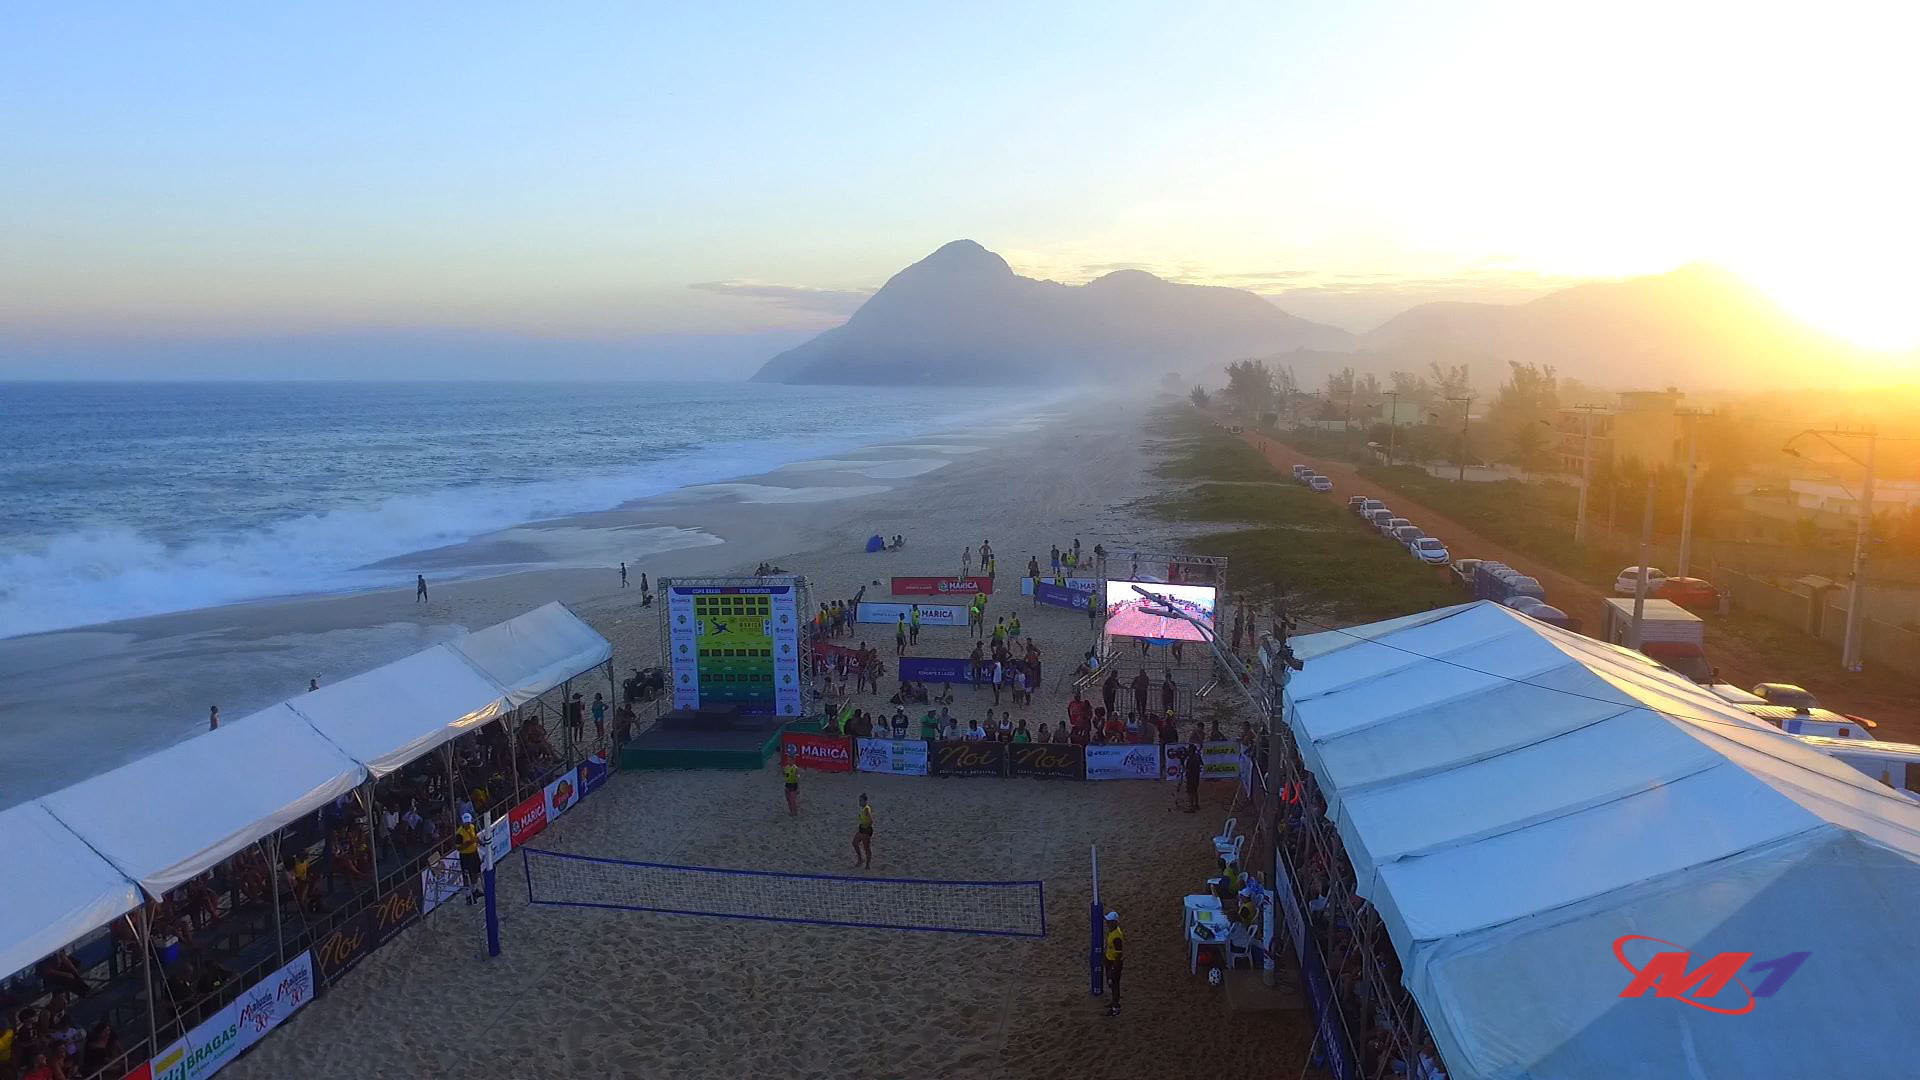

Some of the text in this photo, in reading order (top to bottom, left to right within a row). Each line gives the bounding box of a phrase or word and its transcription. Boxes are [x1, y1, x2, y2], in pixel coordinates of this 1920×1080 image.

[938, 745, 998, 768] Noi
[1017, 746, 1076, 769] Noi
[186, 1024, 238, 1070] BRAGAS
